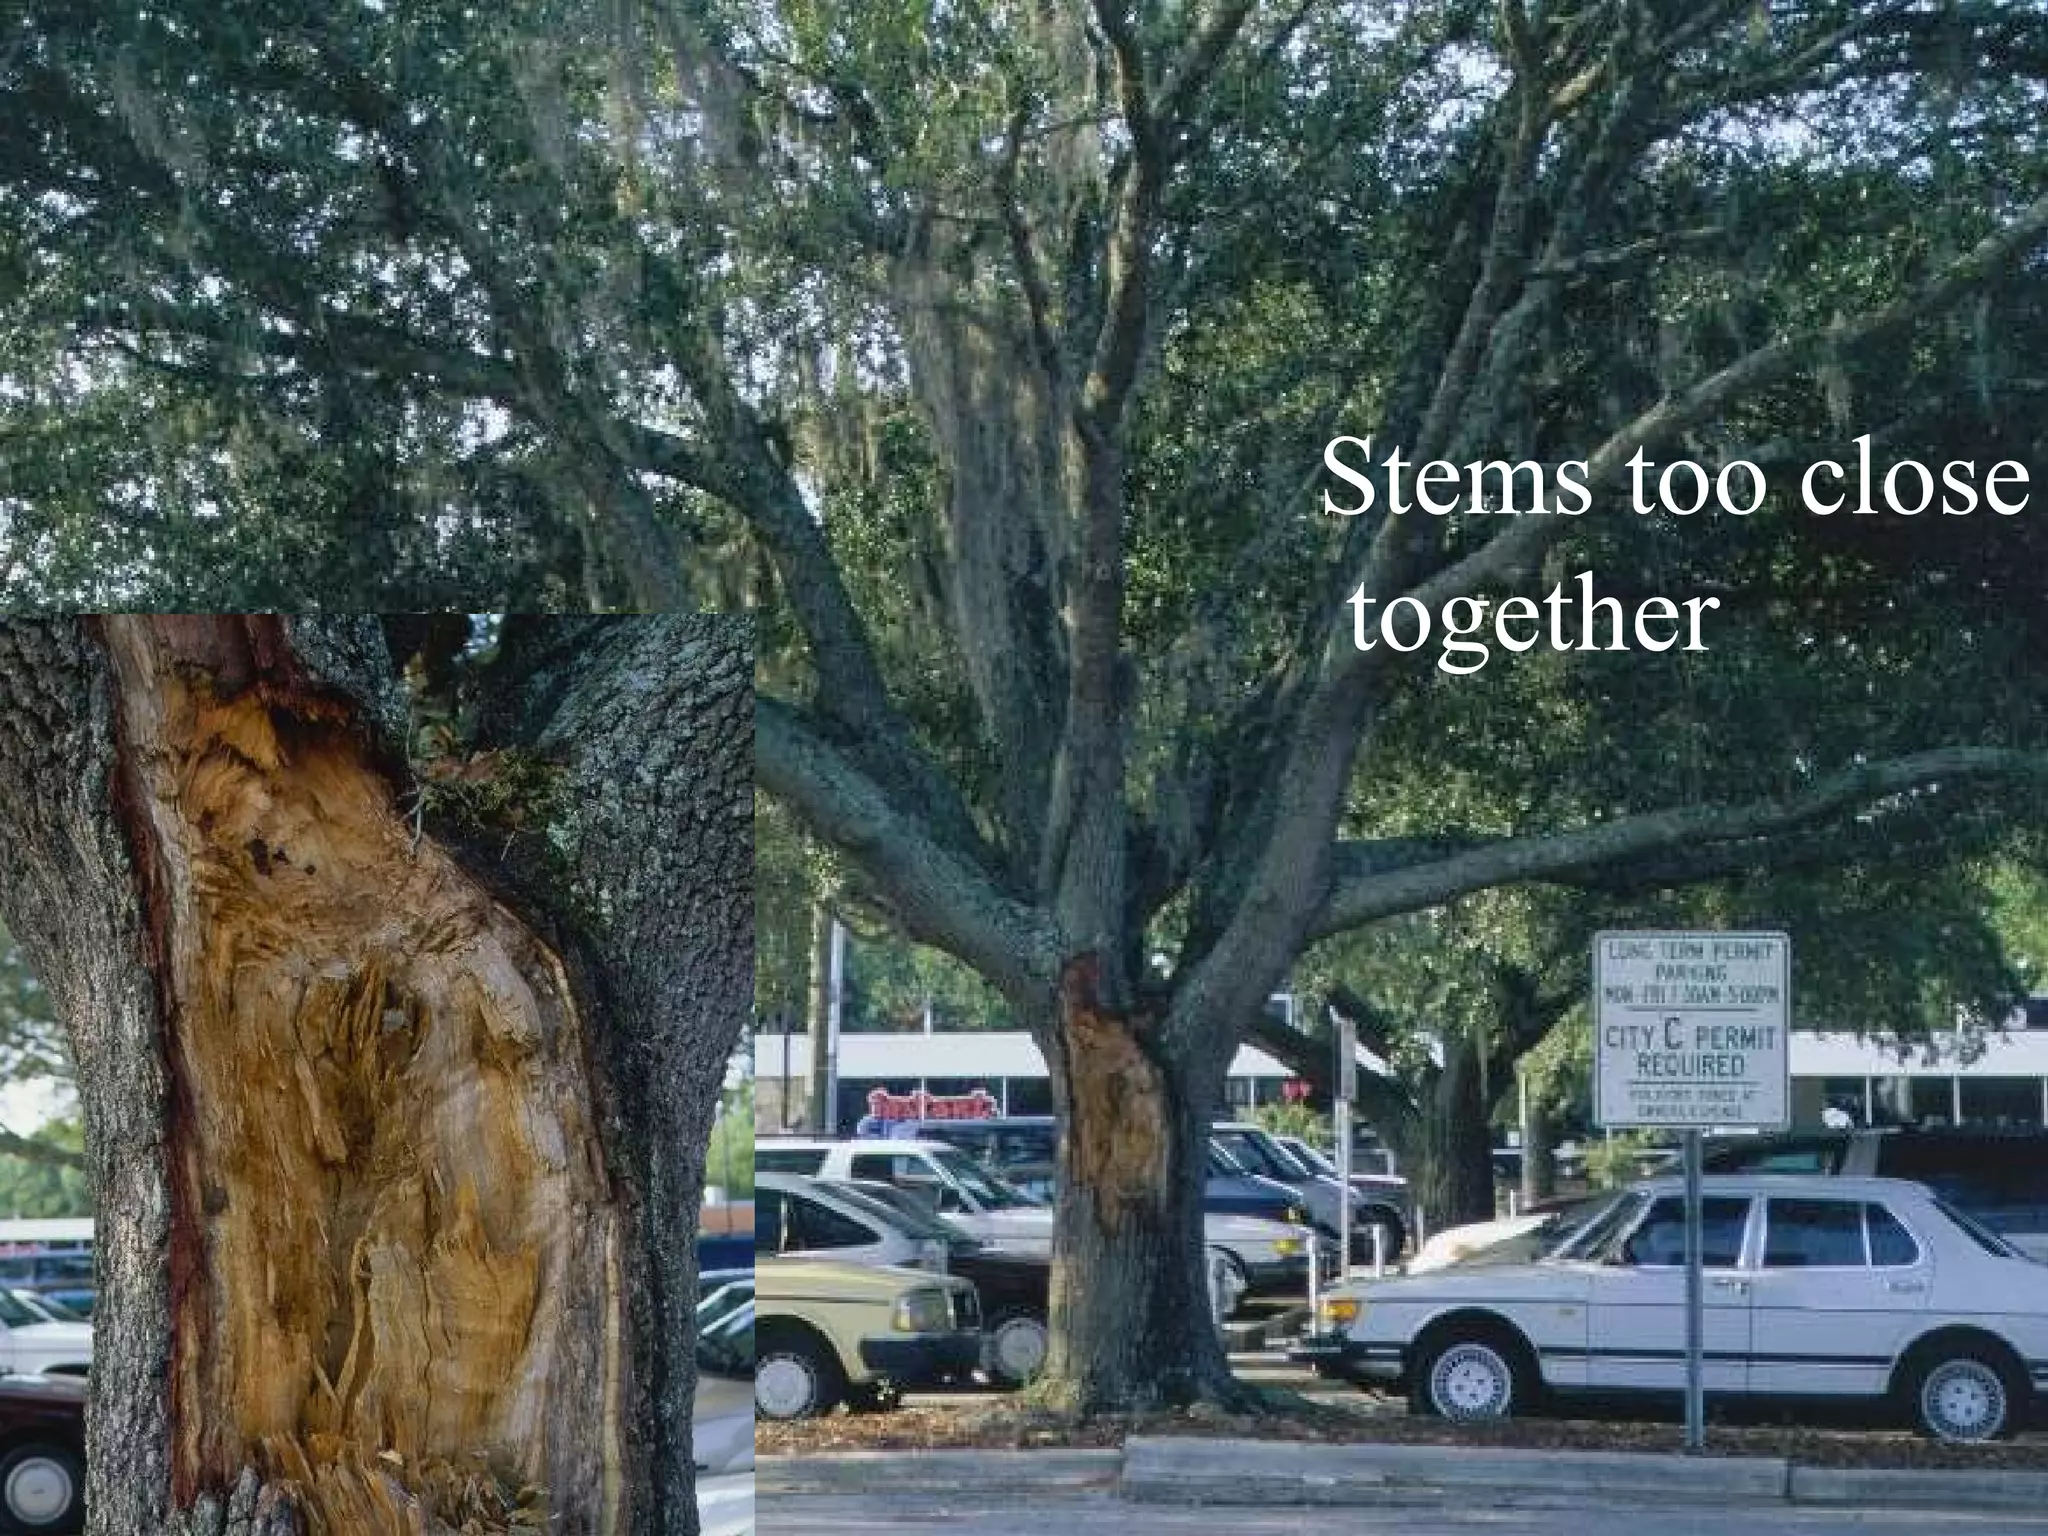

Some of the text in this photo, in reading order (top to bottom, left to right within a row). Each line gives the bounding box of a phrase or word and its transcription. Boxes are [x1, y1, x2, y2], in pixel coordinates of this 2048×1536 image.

[1713, 941, 1776, 961] PERMIT
[1655, 964, 1728, 981] PARKING
[1606, 1017, 1777, 1050] CITY C PERMIT
[1637, 1053, 1745, 1077] REQUIRED
